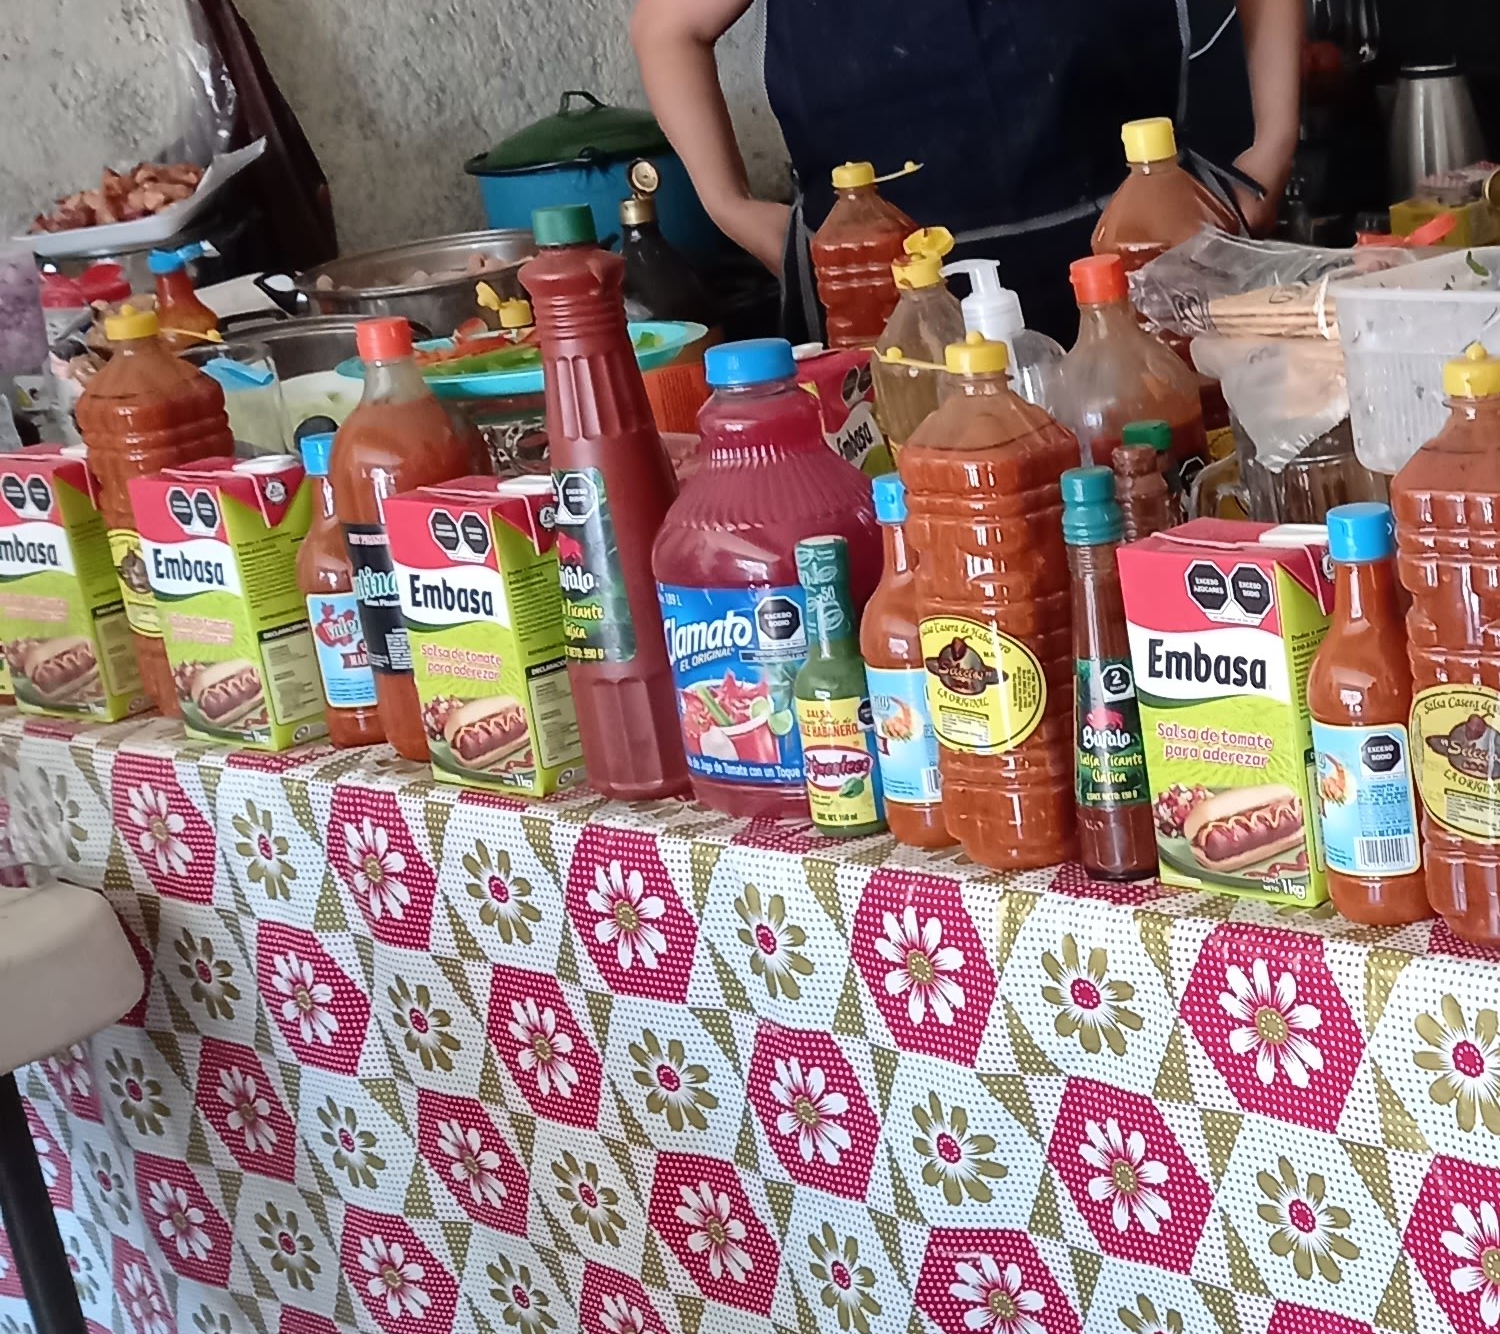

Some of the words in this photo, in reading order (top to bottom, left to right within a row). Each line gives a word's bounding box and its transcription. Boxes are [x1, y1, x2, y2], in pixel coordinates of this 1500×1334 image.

[0, 532, 59, 566] mbasa
[153, 547, 224, 586] Embasa
[559, 565, 595, 594] úfalo
[1194, 576, 1220, 586] EXCESO
[1238, 580, 1262, 590] EXCESO
[409, 573, 494, 616] Embasa
[663, 609, 753, 667] Clamato
[421, 643, 450, 658] Salsa
[451, 646, 465, 660] de
[466, 649, 502, 666] tomate
[679, 659, 691, 673] EL
[691, 648, 733, 665] ORIGINAL
[1148, 637, 1267, 690] Embasa
[427, 662, 451, 677] para
[453, 664, 500, 681] aderezar
[1110, 670, 1122, 685] 2
[1424, 697, 1446, 715] Salsa
[812, 723, 858, 737] HABANERO
[1157, 722, 1197, 741] Salsa
[1200, 727, 1218, 742] de
[1221, 730, 1273, 750] tomate
[1165, 744, 1199, 760] para
[1202, 747, 1269, 767] aderezar
[1367, 744, 1395, 753] EXCESO
[1371, 753, 1393, 761] SODIO
[514, 772, 533, 789] 1kg
[775, 765, 801, 781] Toque
[1281, 876, 1307, 899] 1kg
